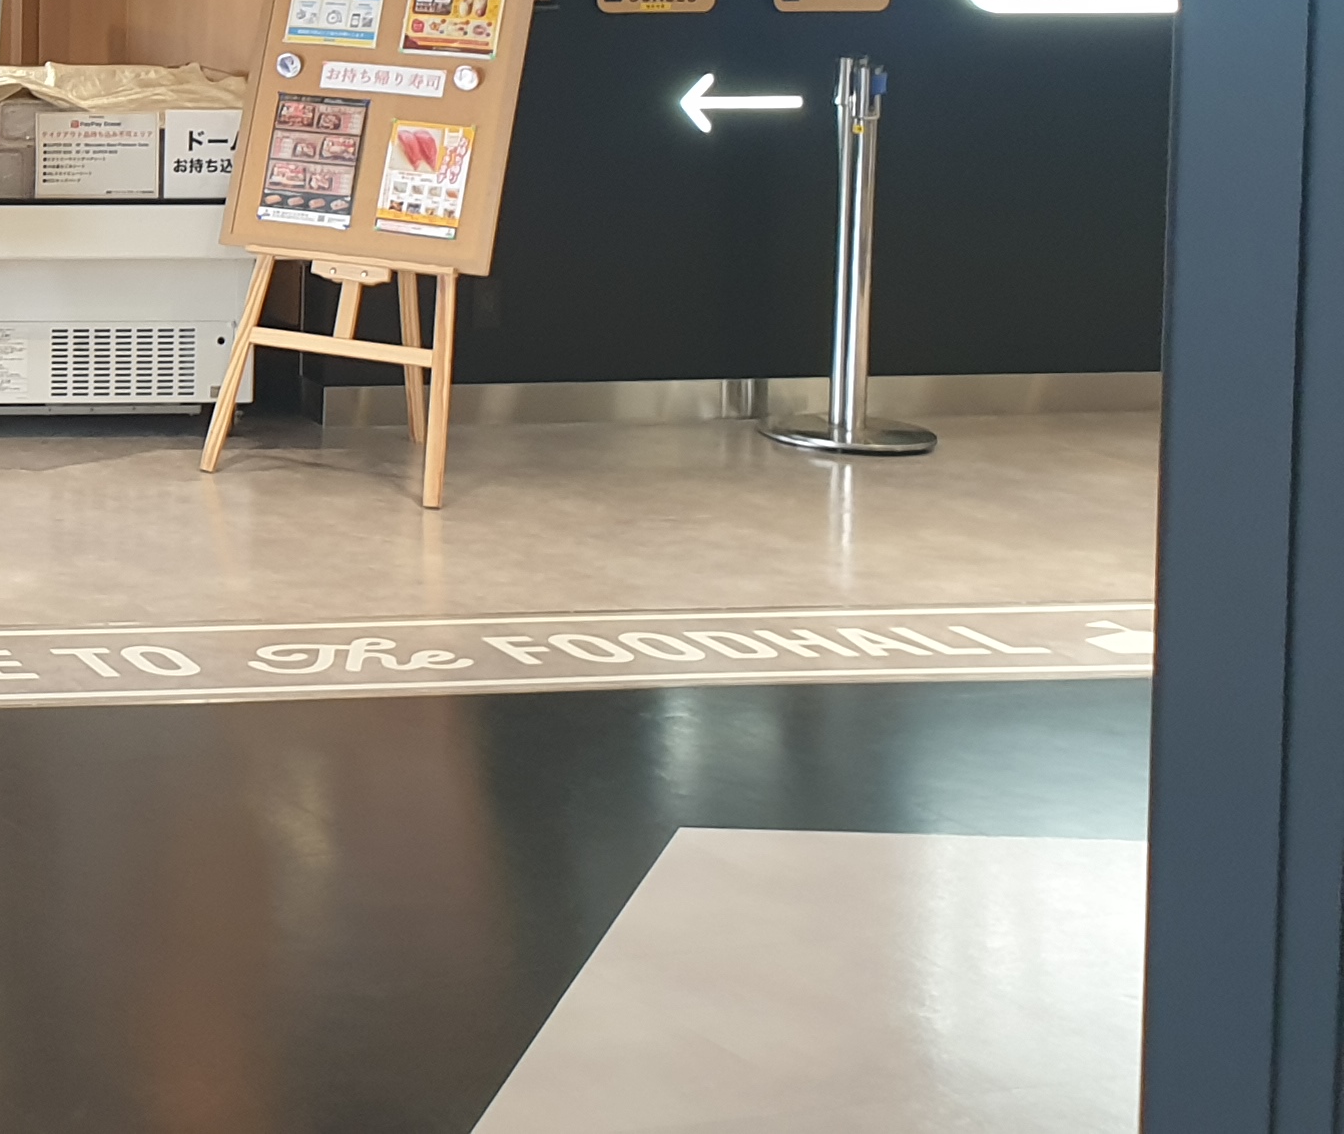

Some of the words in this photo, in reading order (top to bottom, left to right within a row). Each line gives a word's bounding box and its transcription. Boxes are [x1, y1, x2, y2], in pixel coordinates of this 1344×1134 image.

[325, 66, 443, 92] お持ち帰り寿司
[49, 645, 202, 679] TO
[248, 637, 475, 674] The
[480, 625, 1054, 666] FOODHALL
